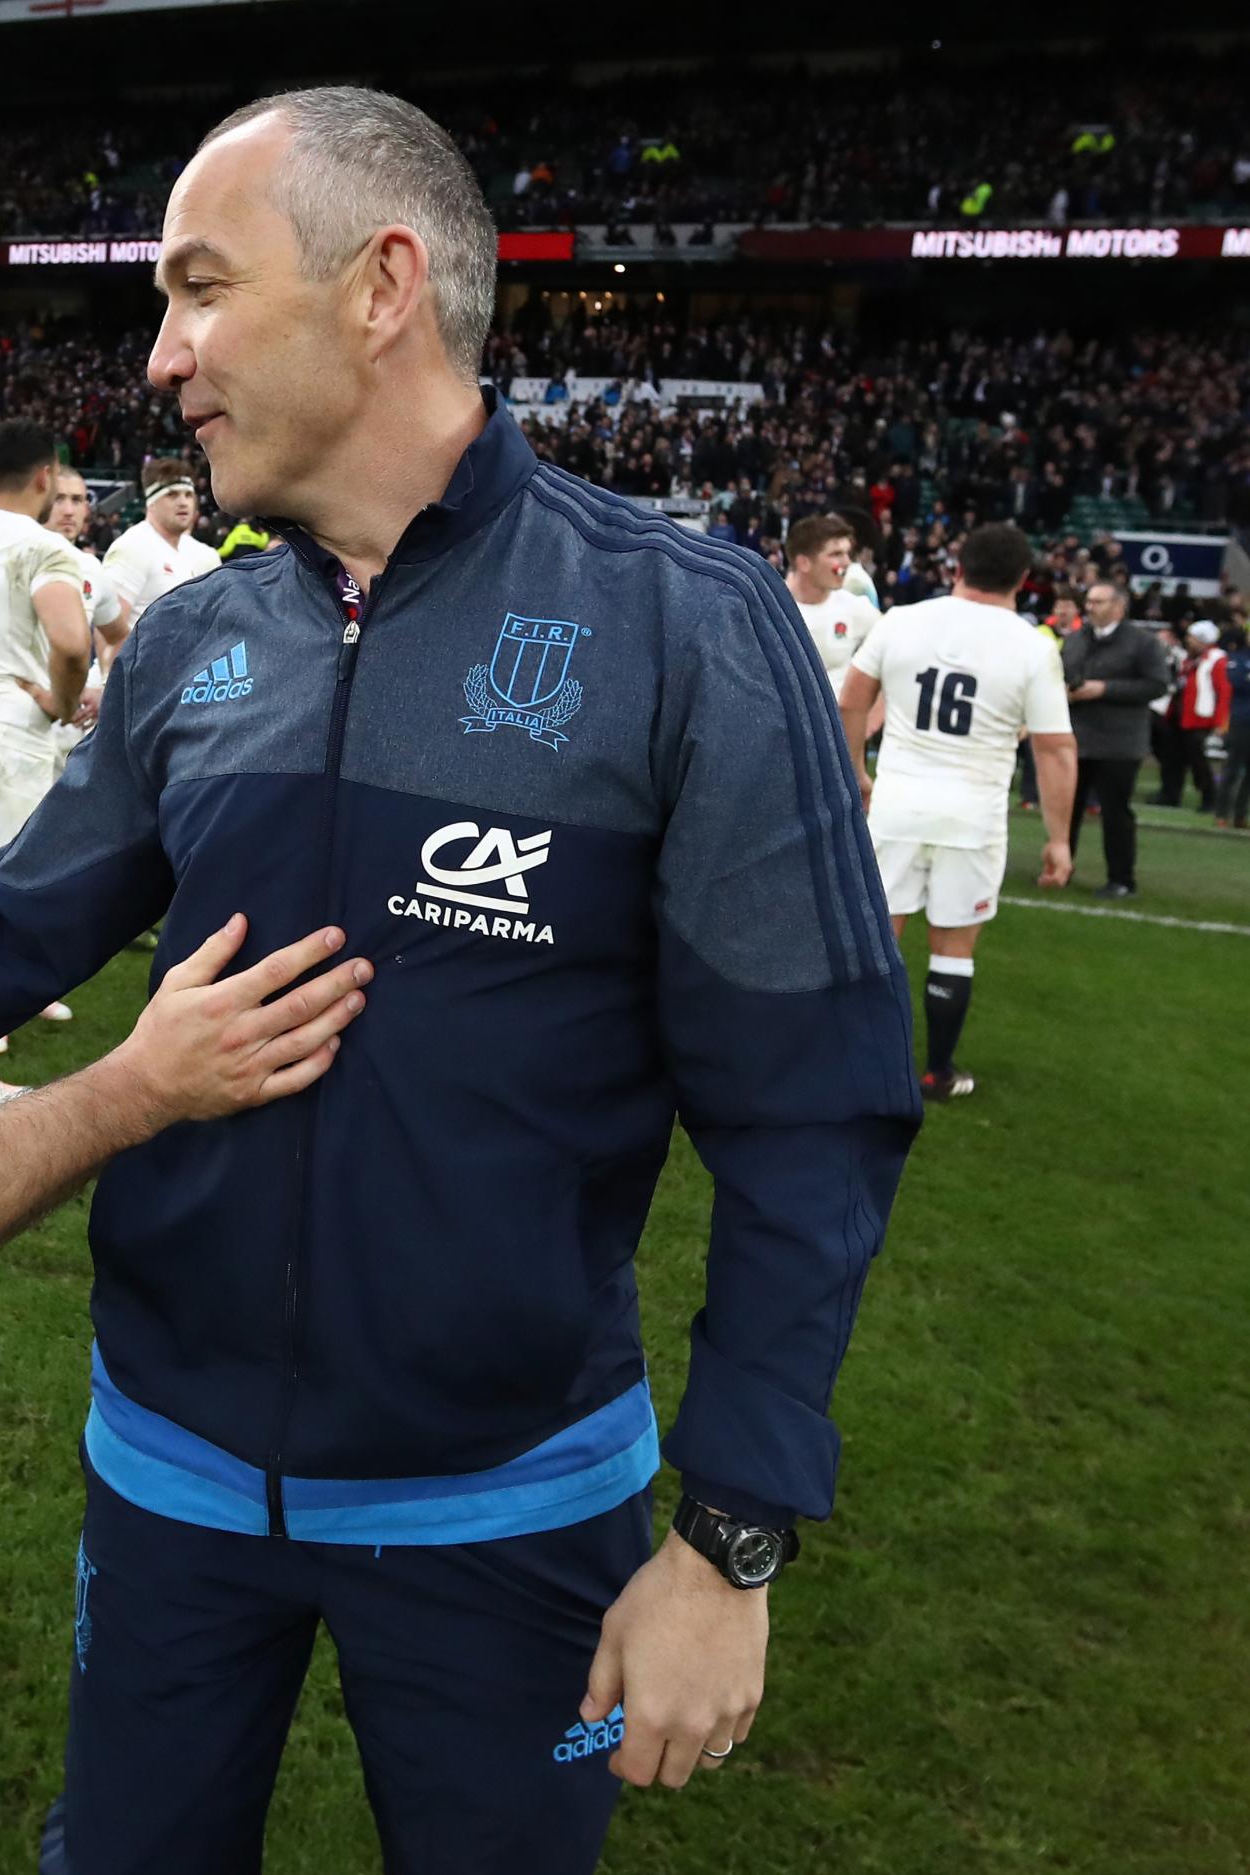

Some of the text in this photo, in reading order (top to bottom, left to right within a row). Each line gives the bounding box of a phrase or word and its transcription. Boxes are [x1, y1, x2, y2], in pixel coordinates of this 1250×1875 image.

[8, 241, 163, 265] MITSUBISHI MOTO
[912, 229, 1179, 258] MITSUBISHI MOTORS
[511, 621, 569, 641] F.I.R.
[180, 678, 254, 705] adidas
[915, 667, 978, 736] 16
[491, 710, 540, 729] ITALIA
[387, 895, 554, 944] CARIPARMA
